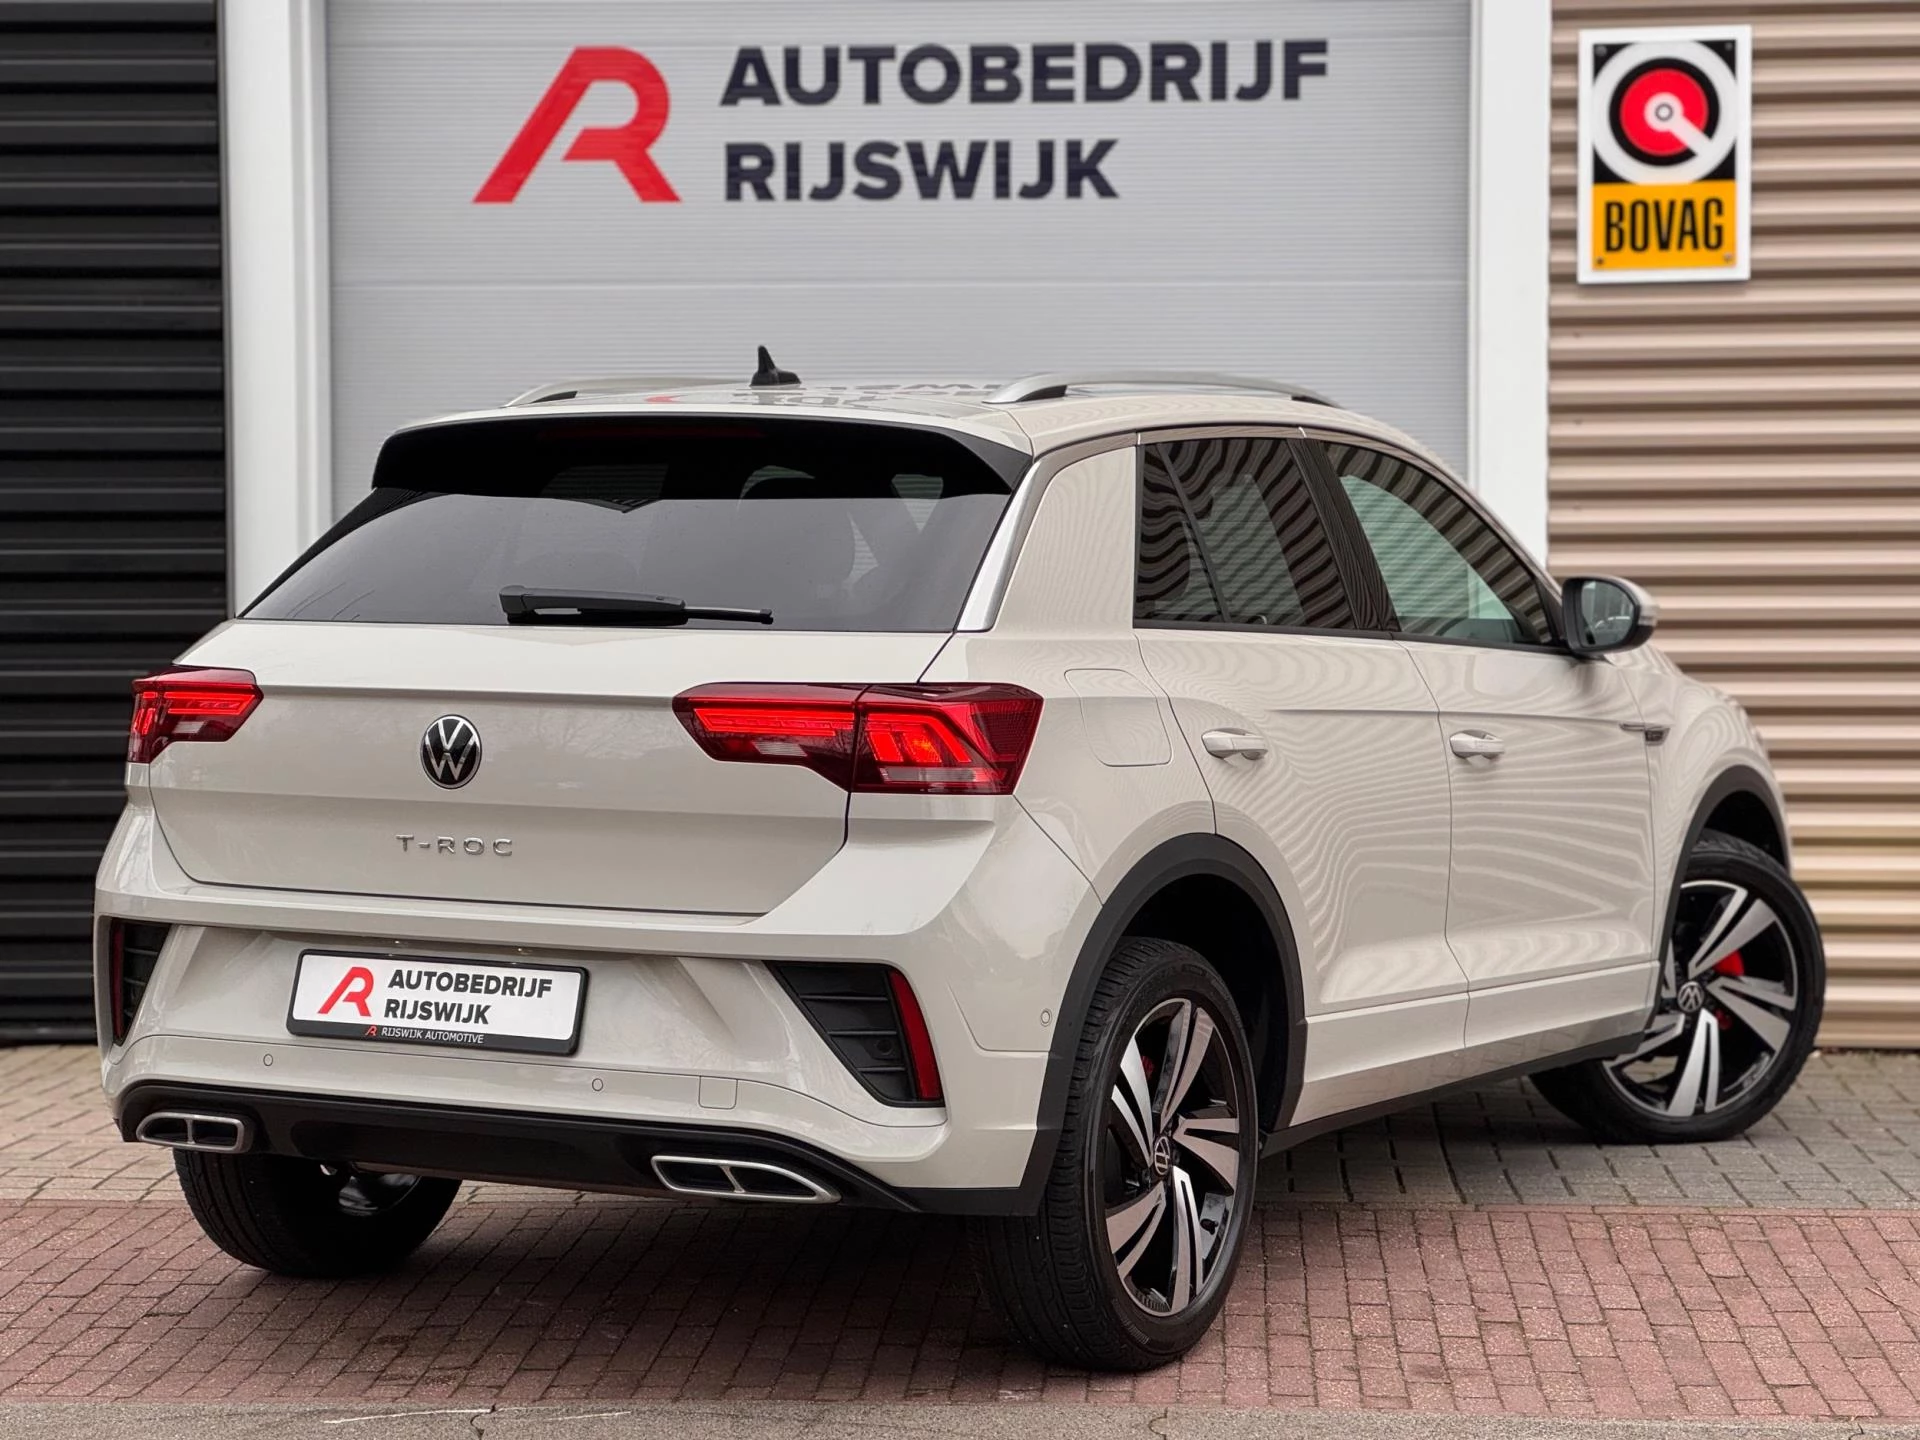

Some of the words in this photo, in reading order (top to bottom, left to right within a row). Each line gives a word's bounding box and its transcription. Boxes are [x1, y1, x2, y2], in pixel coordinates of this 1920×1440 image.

[720, 39, 1329, 106] AUTOBEDRIJF
[724, 139, 1120, 201] RIJSWIJK
[1604, 197, 1724, 252] BOVAG
[396, 834, 513, 857] T-ROC
[387, 969, 553, 999] AUTOBEDRIJF
[384, 999, 492, 1025] RIJSWIJK
[381, 1027, 423, 1039] RIJSWIJK
[424, 1031, 484, 1044] AUTOMOTIVE
